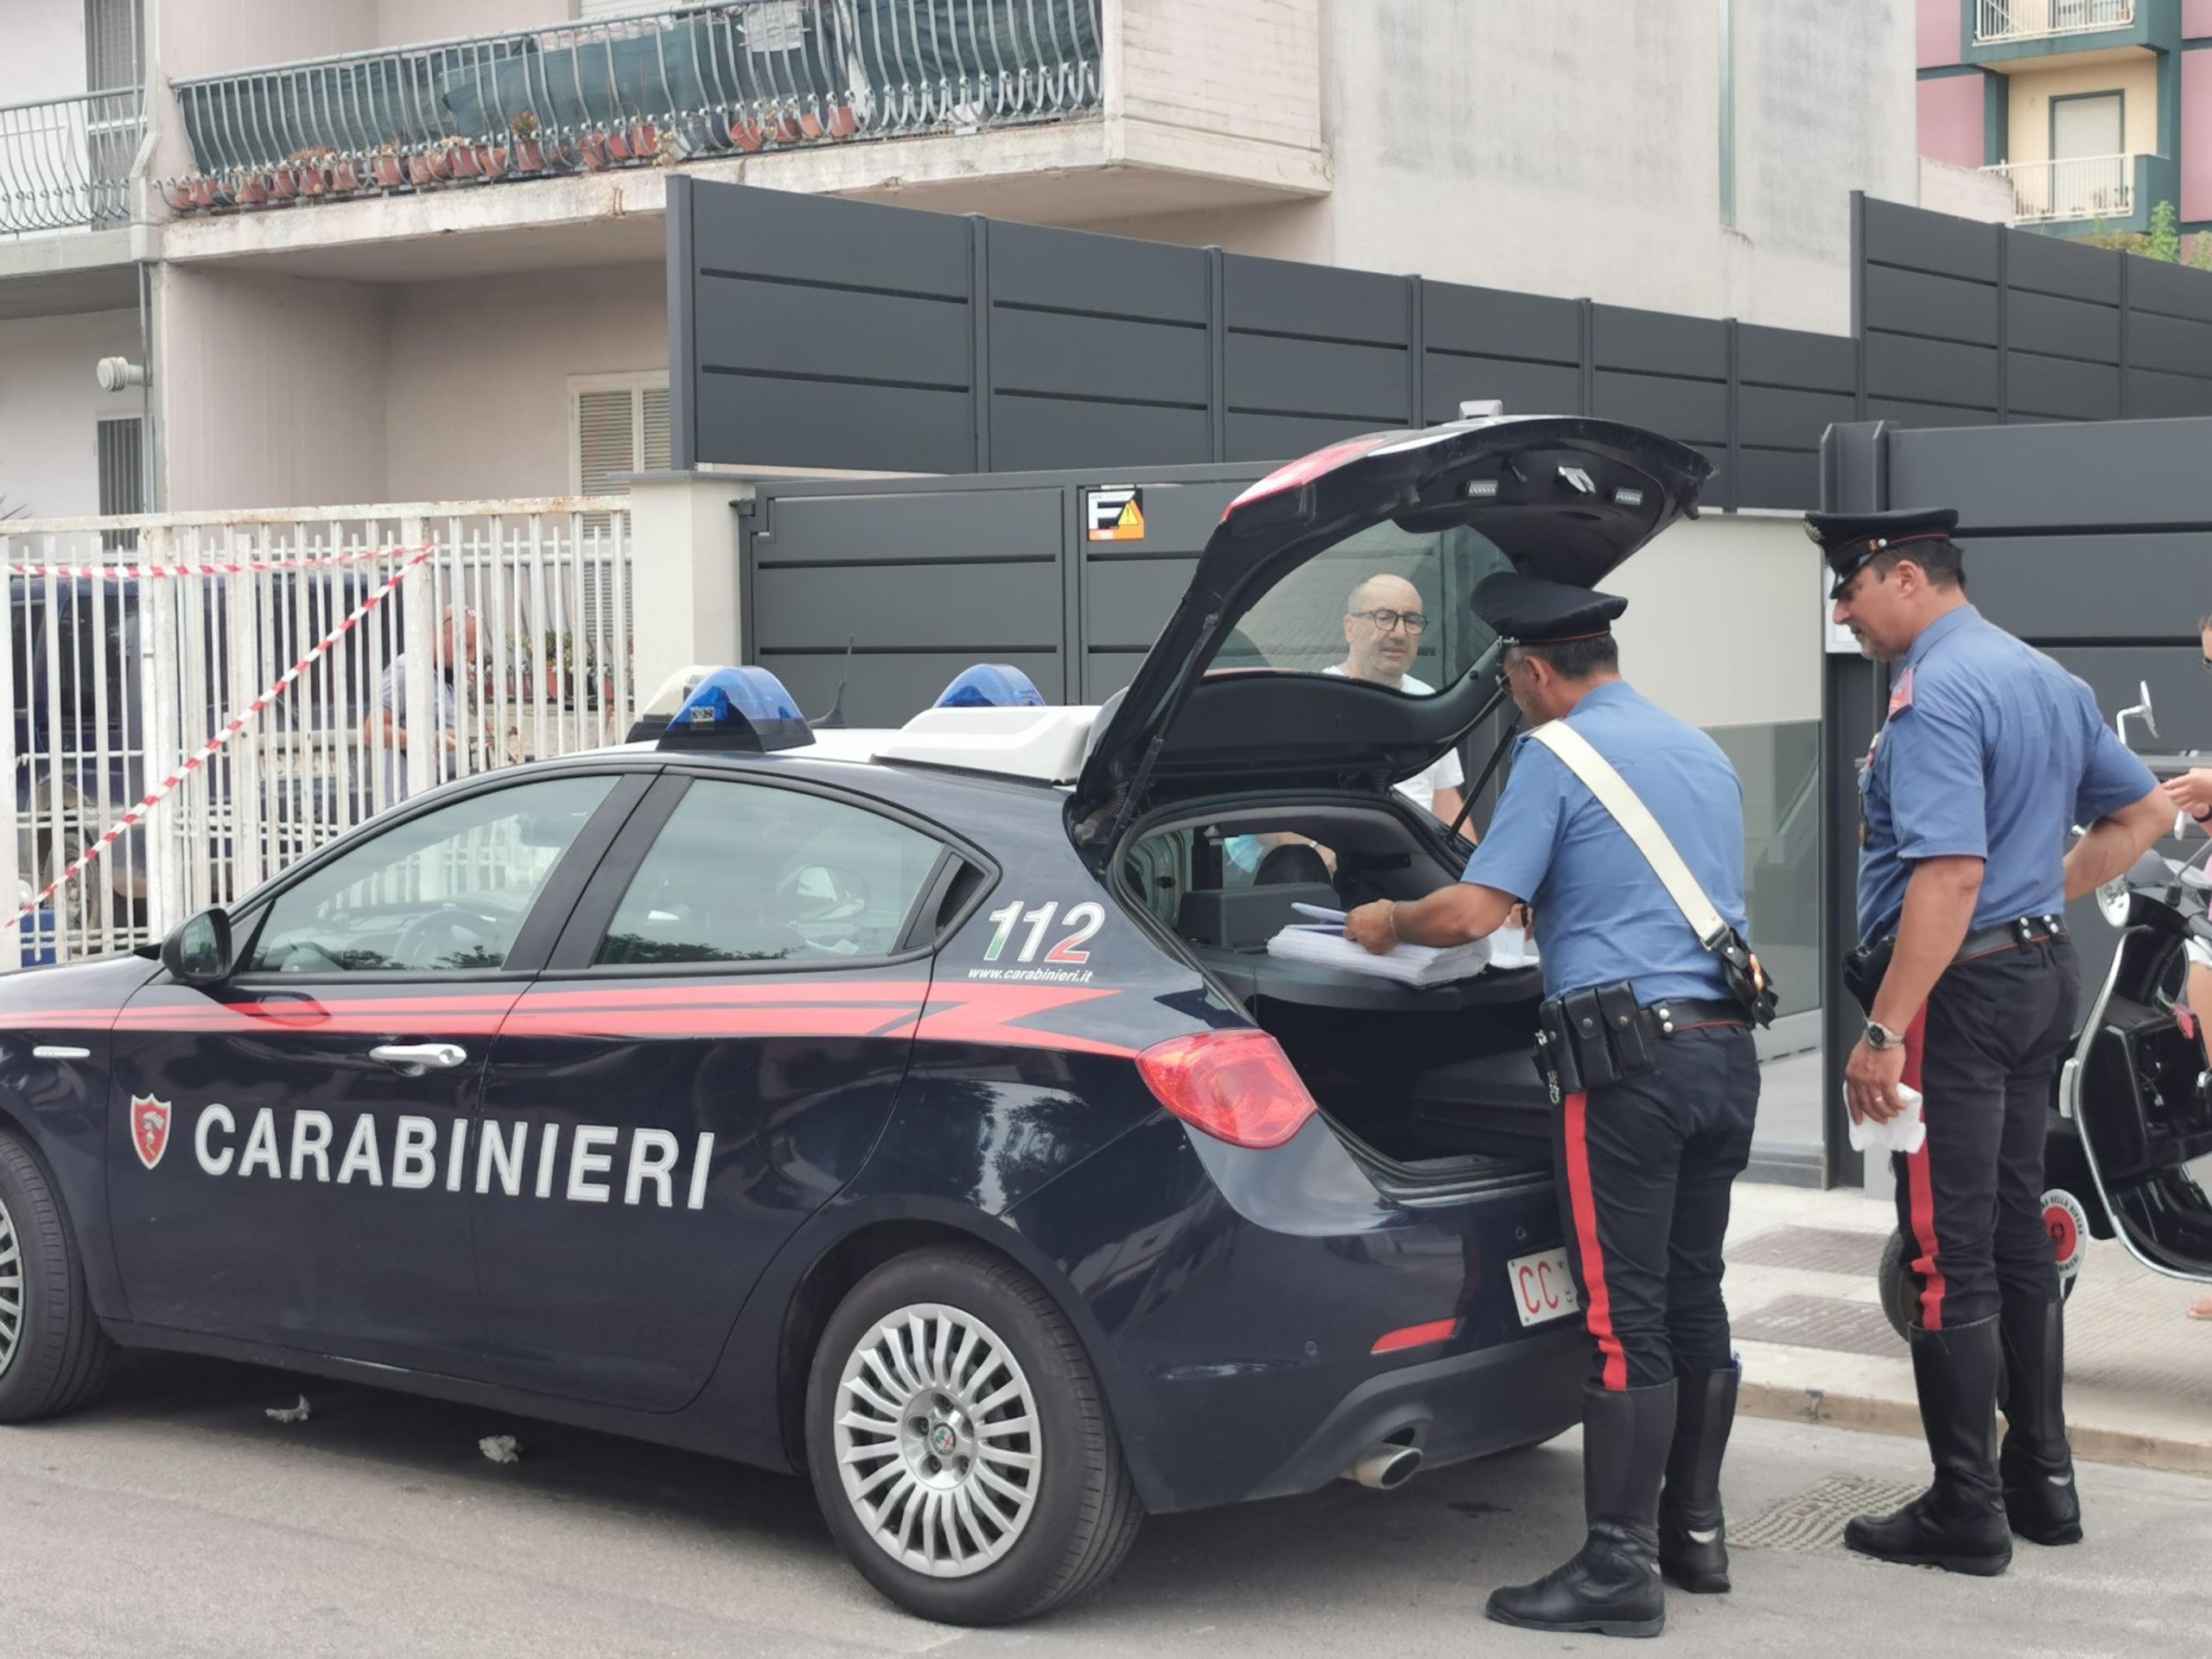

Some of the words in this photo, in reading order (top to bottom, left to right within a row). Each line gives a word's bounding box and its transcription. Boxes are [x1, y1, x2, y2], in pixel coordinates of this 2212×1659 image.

[983, 900, 1106, 964] 112
[968, 967, 1094, 983] www.carabinieri.it
[194, 1103, 715, 1211] CARABINIERI
